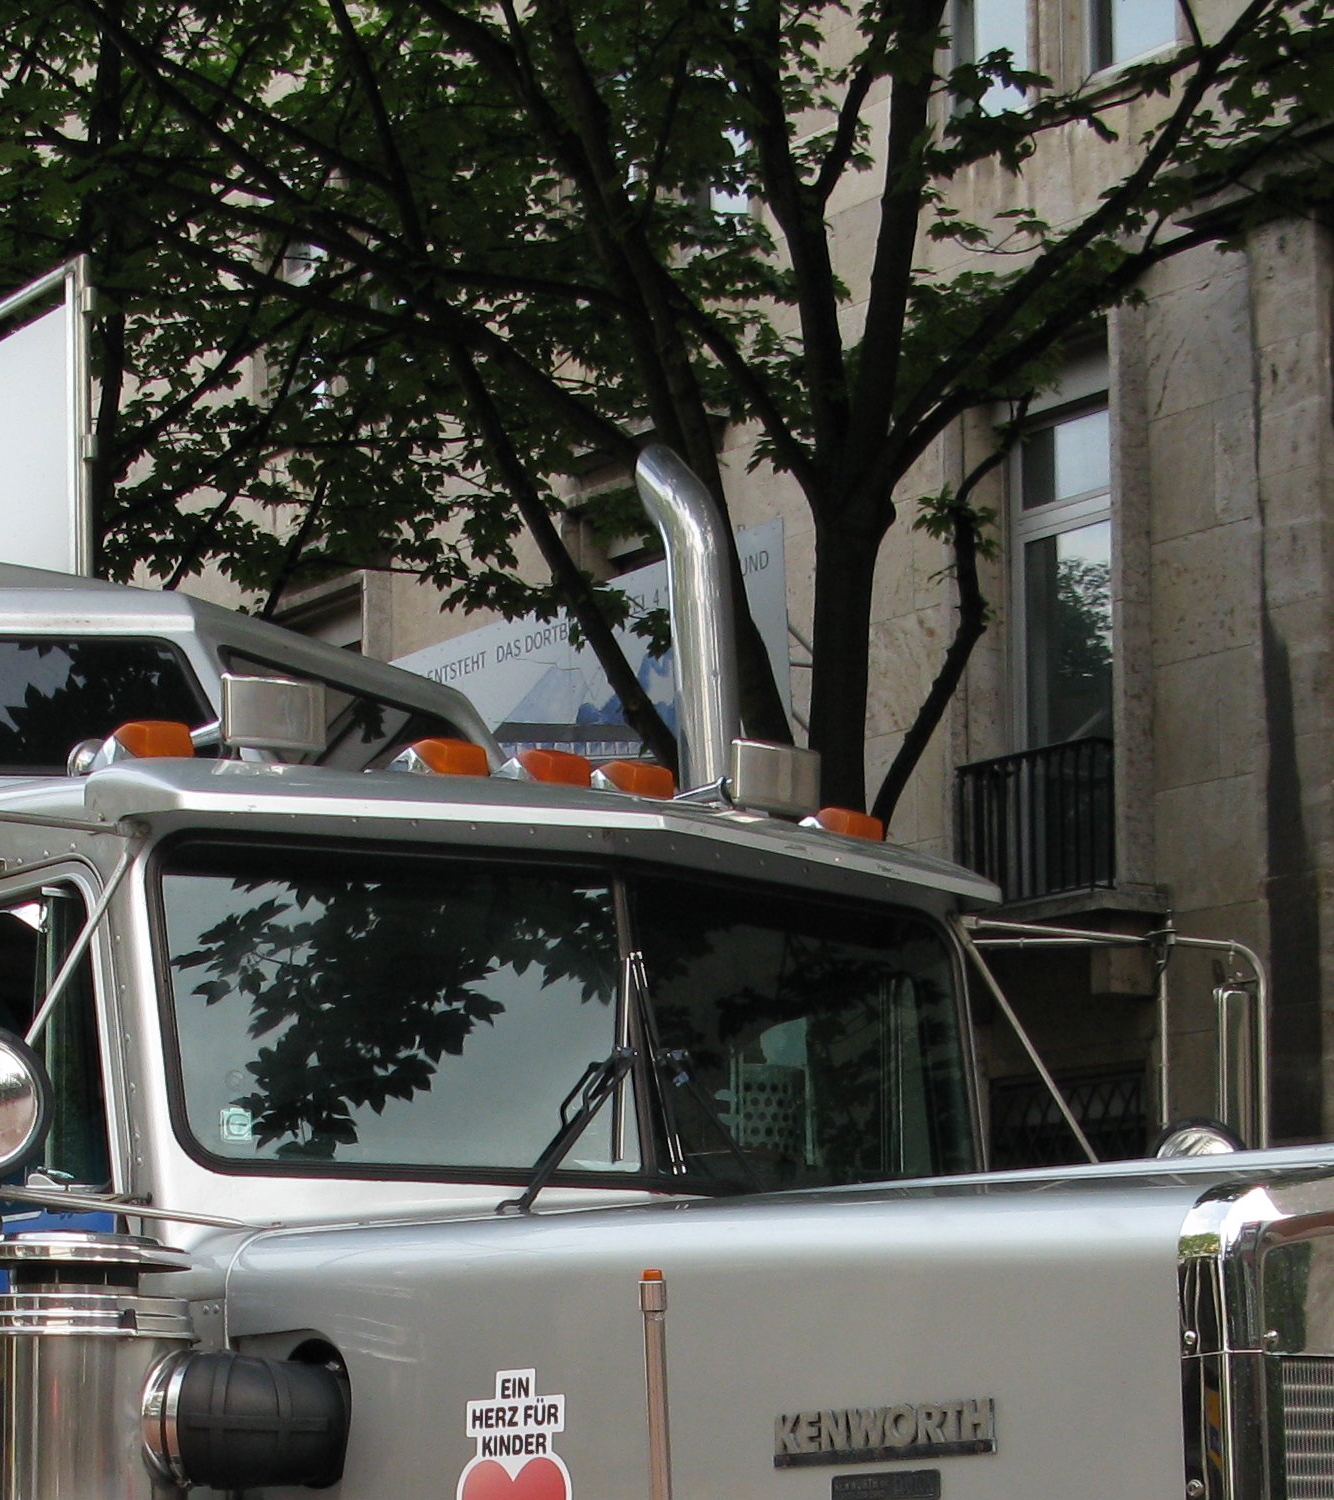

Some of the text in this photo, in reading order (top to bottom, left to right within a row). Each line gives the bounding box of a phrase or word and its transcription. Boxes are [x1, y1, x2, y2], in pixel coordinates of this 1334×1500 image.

[496, 639, 522, 663] DAS
[525, 622, 569, 654] DORTB
[739, 550, 769, 577] UND
[501, 1377, 529, 1399] EIN
[472, 1397, 558, 1429] HERZ FÜR
[775, 1398, 994, 1456] KENWORTH
[482, 1433, 547, 1458] KINDER
